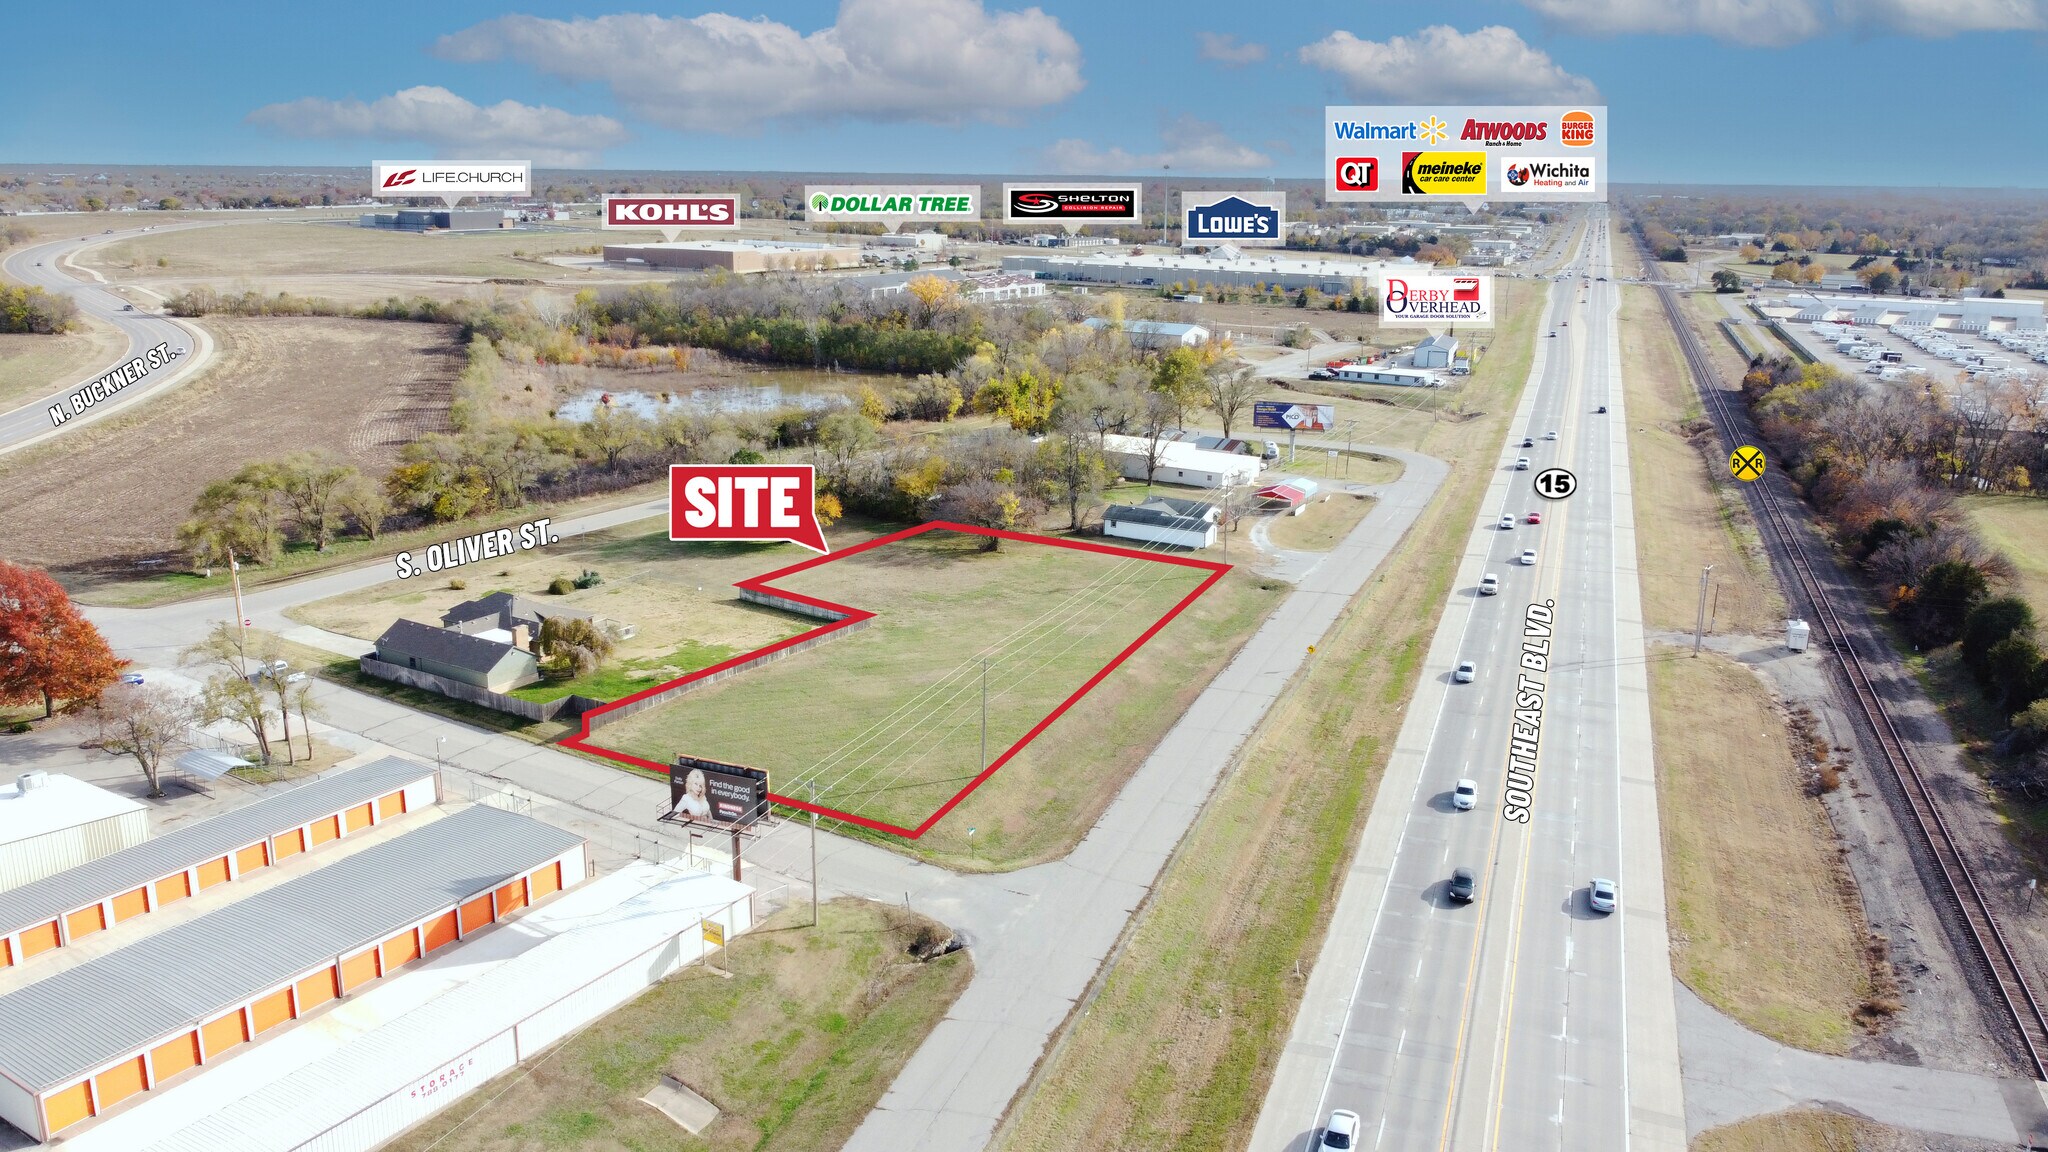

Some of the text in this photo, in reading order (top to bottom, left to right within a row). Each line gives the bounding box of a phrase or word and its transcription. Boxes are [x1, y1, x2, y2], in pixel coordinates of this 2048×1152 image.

[709, 779, 750, 794] Find the good
[717, 789, 750, 803] everybody.
[411, 1058, 473, 1099] STORAGE
